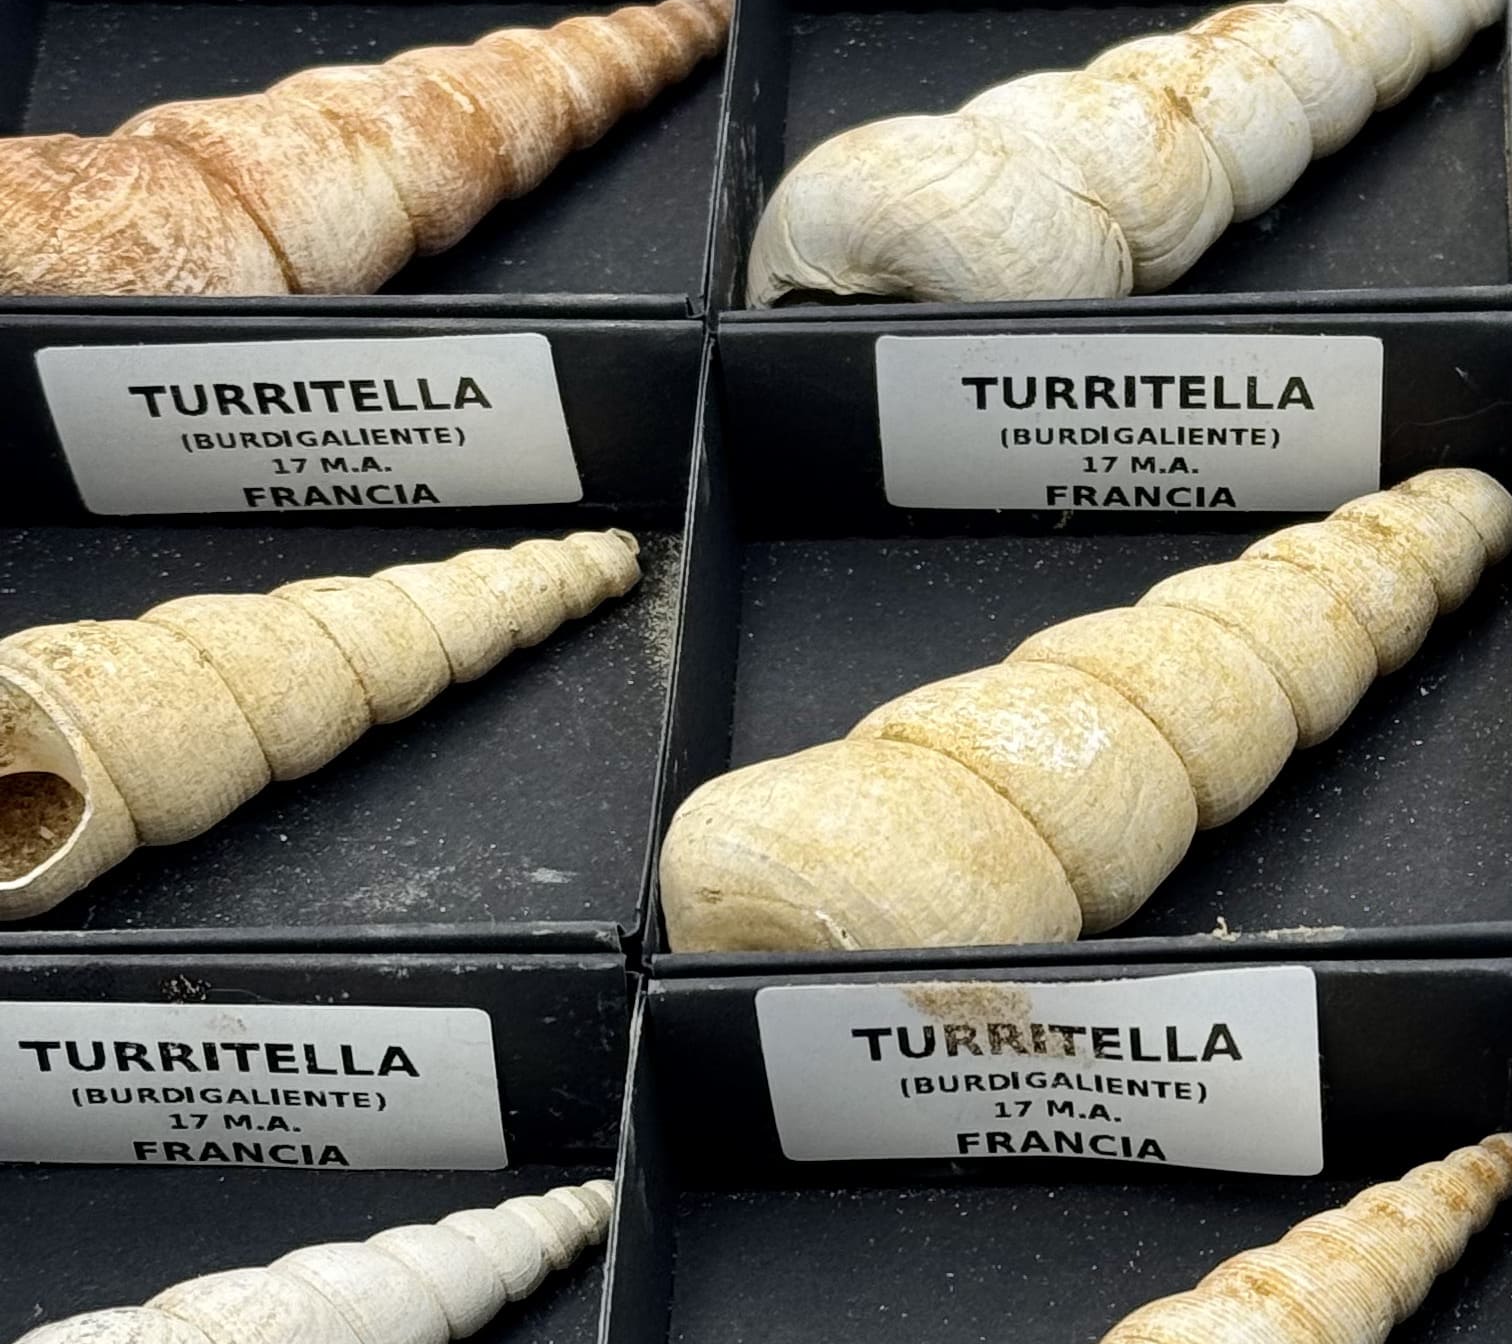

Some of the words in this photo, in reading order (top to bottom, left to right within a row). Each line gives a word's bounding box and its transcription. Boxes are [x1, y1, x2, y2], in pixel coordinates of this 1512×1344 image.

[129, 376, 491, 418] TURRITELLA
[962, 375, 1315, 412] TURRITELLA
[181, 426, 466, 454] (BURDIGALIENTE)
[1000, 426, 1280, 450] (BURDIGALIENTE)
[272, 457, 310, 475] 17
[321, 455, 392, 474] M.A.
[1082, 456, 1119, 475] 17
[1131, 456, 1199, 475] M.A.
[243, 482, 441, 508] FRANCIA
[1046, 485, 1237, 509] FRANCIA
[852, 1023, 1242, 1063] TURRITELLA
[19, 1039, 420, 1078] TURRITELLA
[72, 1086, 386, 1112] (BURDIGALIENTE)
[900, 1070, 1209, 1104] (BURDIGALIENTE)
[169, 1115, 208, 1132] 17
[221, 1114, 302, 1133] M.A.
[993, 1102, 1032, 1120] 17
[1044, 1103, 1122, 1124] M.A.
[133, 1140, 350, 1168] FRANCIA
[956, 1131, 1167, 1162] FRANCIA
